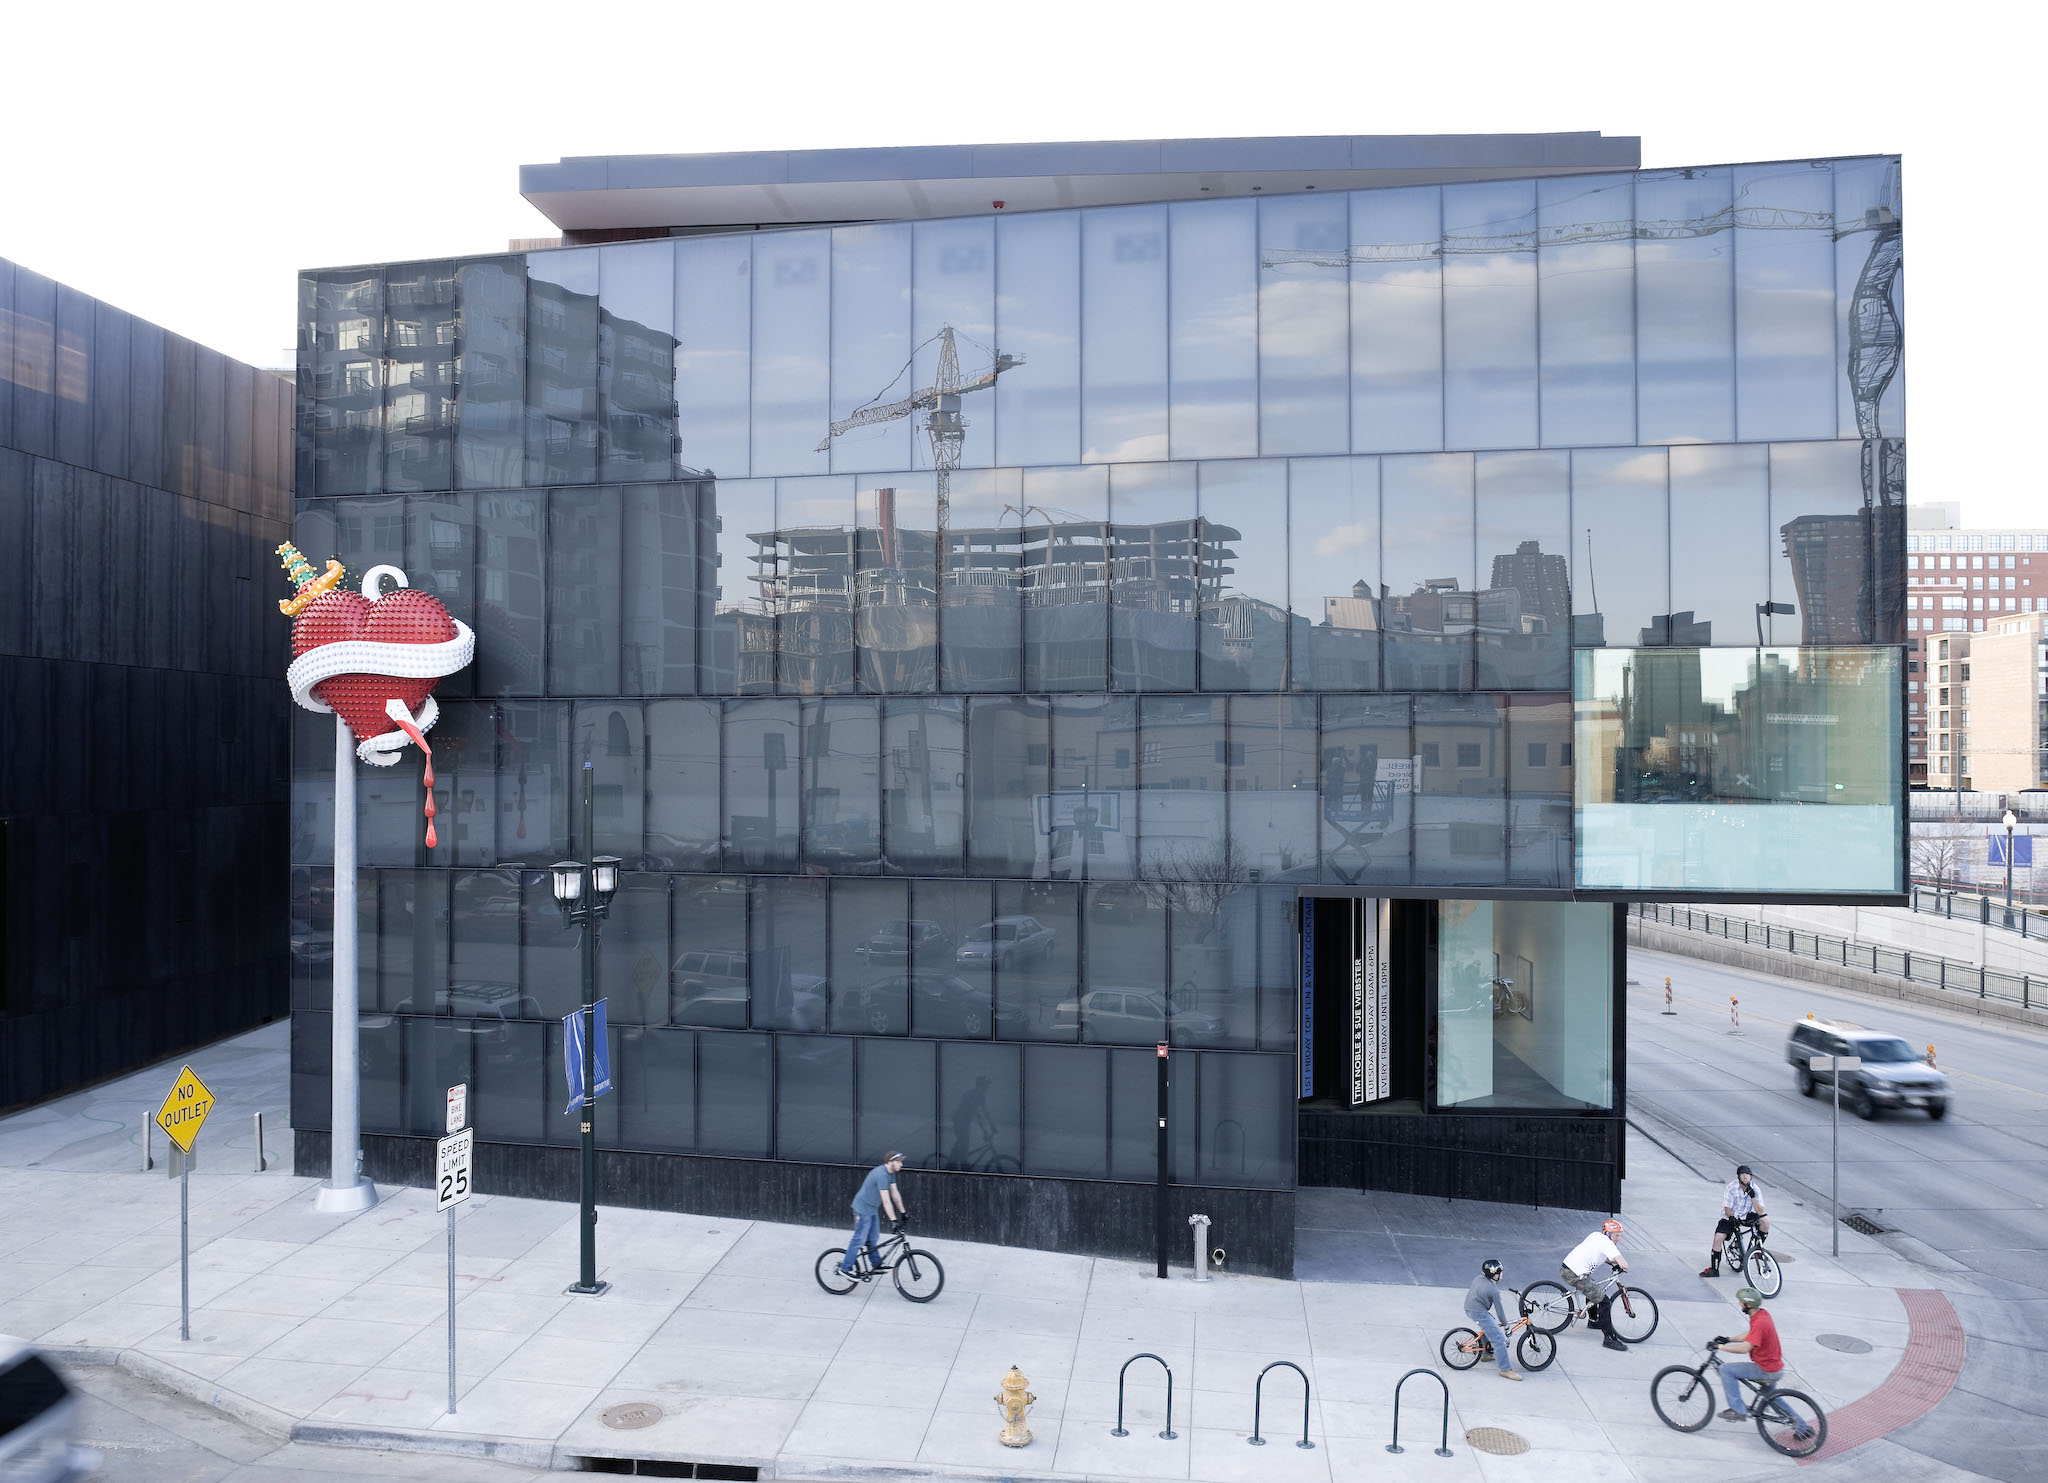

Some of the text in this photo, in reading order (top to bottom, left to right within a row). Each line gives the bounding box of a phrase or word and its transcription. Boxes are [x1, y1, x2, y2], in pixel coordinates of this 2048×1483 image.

[1354, 1031, 1361, 1039] &
[178, 1083, 194, 1102] NO
[164, 1100, 208, 1128] OUTLET
[451, 1103, 462, 1114] BIKE
[450, 1114, 462, 1126] LANE
[441, 1138, 469, 1159] SPEED
[443, 1154, 466, 1172] LIMIT
[440, 1167, 467, 1203] 25
